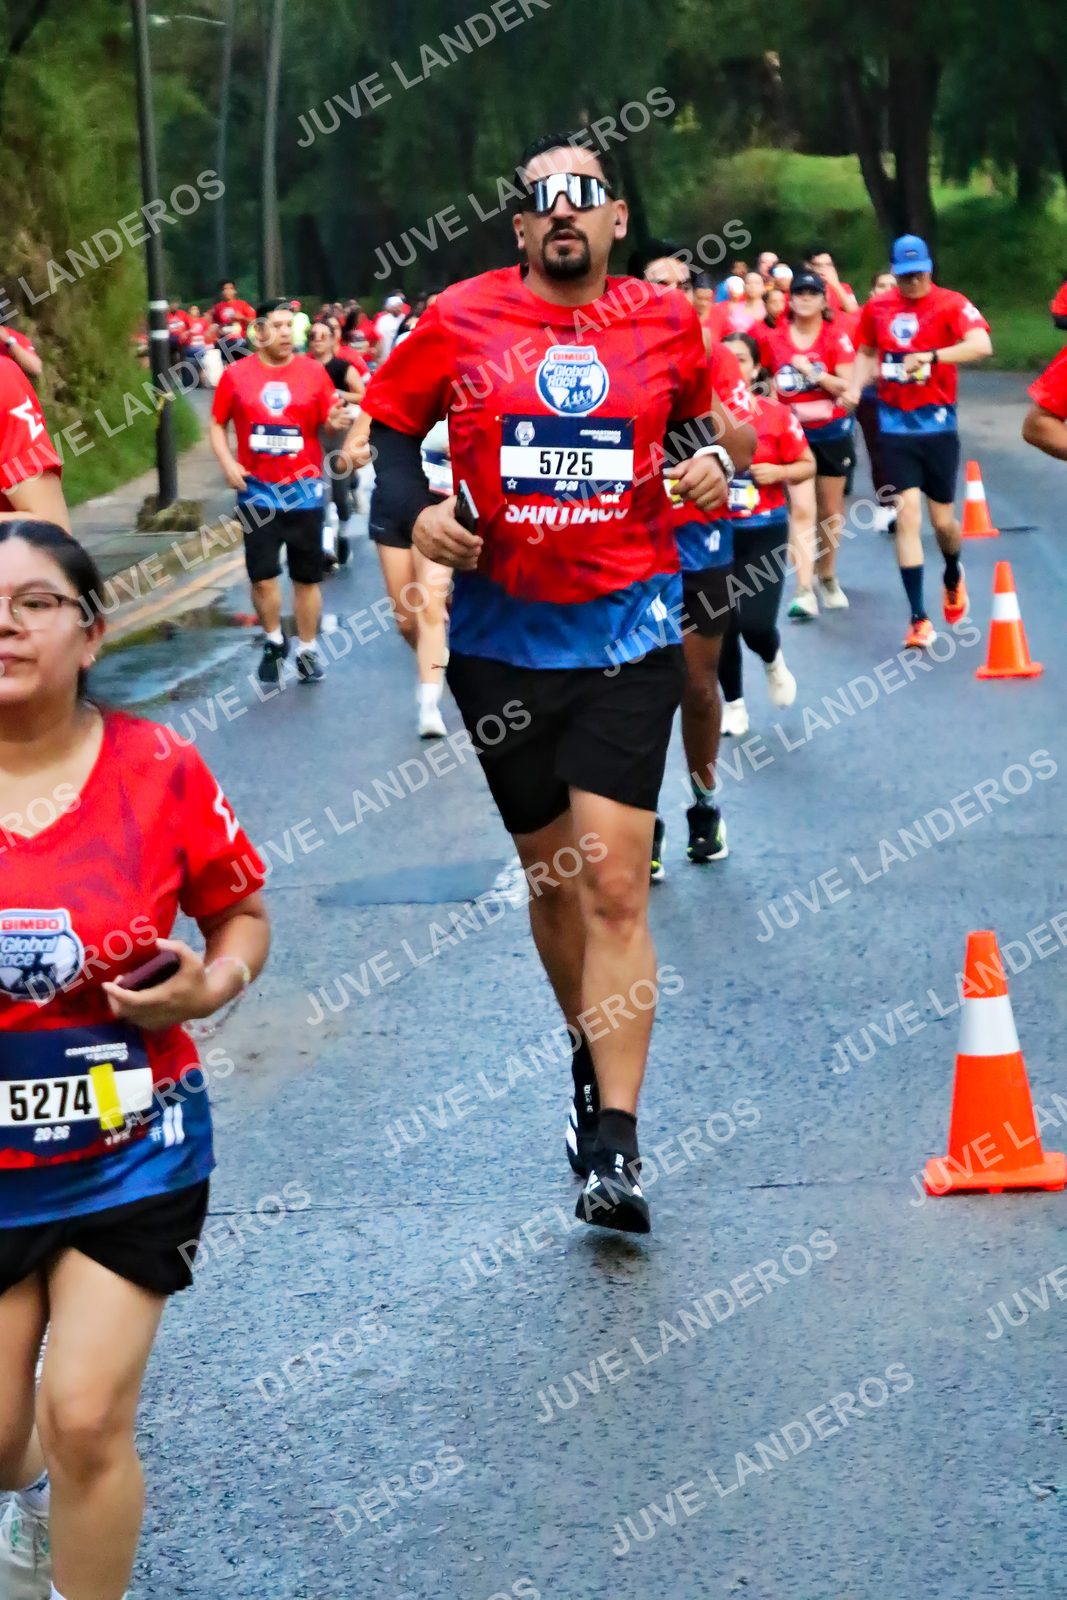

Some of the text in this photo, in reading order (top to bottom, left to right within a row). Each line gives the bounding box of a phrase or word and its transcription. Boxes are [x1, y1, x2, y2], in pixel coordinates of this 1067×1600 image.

[553, 353, 590, 361] BIMBO
[554, 365, 591, 377] Global
[546, 375, 577, 388] Race
[539, 451, 593, 476] 5725
[1, 919, 59, 930] BIMBO
[0, 936, 58, 953] Global
[0, 953, 35, 966] ace
[9, 1079, 92, 1121] 5274
